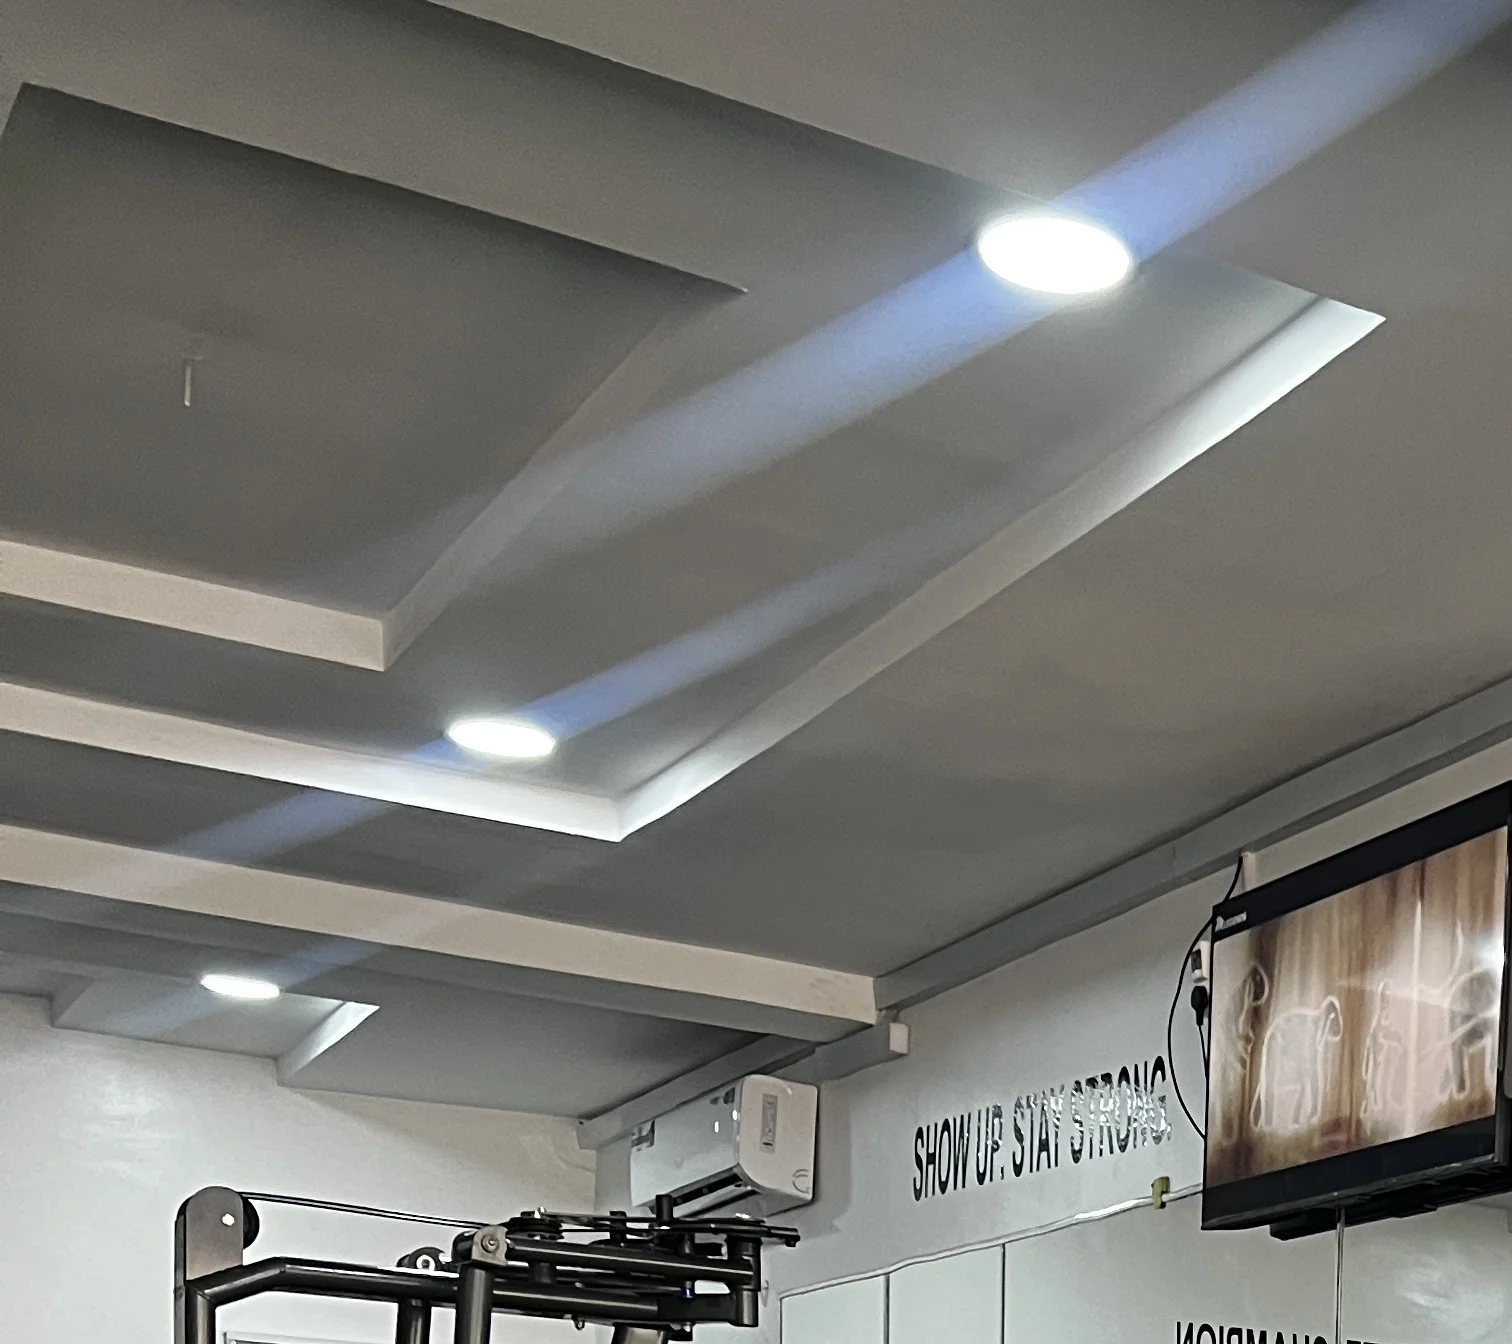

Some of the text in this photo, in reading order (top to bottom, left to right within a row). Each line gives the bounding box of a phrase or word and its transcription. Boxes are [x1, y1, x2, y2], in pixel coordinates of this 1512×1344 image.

[913, 1055, 1172, 1202] SHOW UP. STAY STRONG.
